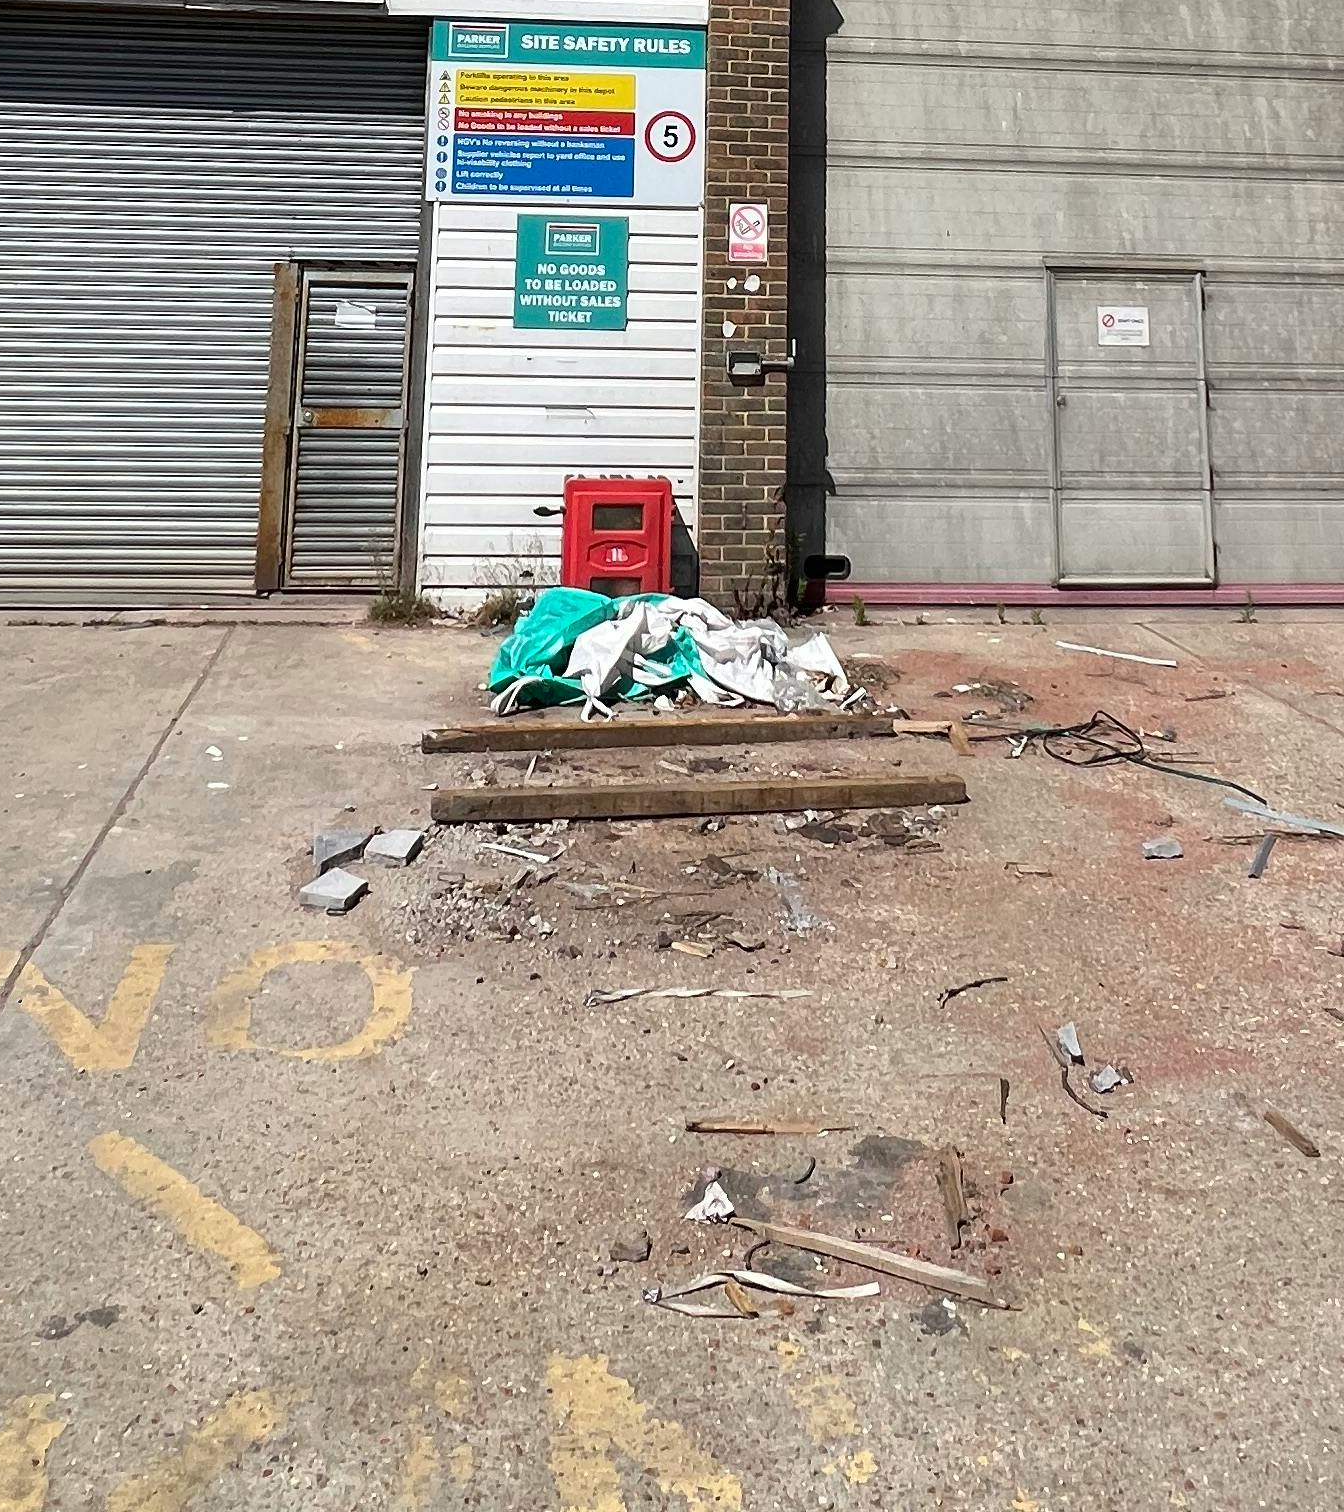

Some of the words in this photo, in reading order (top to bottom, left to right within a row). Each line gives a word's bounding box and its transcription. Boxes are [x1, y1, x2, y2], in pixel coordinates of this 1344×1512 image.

[458, 34, 500, 43] PARKER
[521, 35, 559, 49] SITE
[563, 36, 629, 52] SAFETY
[634, 39, 690, 54] RULES
[530, 86, 568, 94] machinery
[491, 96, 533, 104] pedestrians
[471, 111, 503, 119] smoking
[529, 112, 563, 120] buildings
[517, 123, 542, 131] loaded
[544, 124, 571, 132] without
[663, 125, 678, 148] 5
[495, 140, 529, 148] reversing
[458, 150, 488, 158] Supplier
[556, 153, 572, 161] yard
[501, 160, 531, 168] clothing
[471, 171, 503, 180] correctly
[554, 234, 591, 242] PARKER
[538, 264, 556, 274] NO
[560, 264, 605, 276] GOODS
[525, 279, 541, 290] TO
[545, 280, 562, 290] BE
[565, 280, 616, 291] LOADED
[520, 295, 578, 306] WITHOUT
[580, 296, 621, 307] SALES
[548, 311, 592, 322] TICKET
